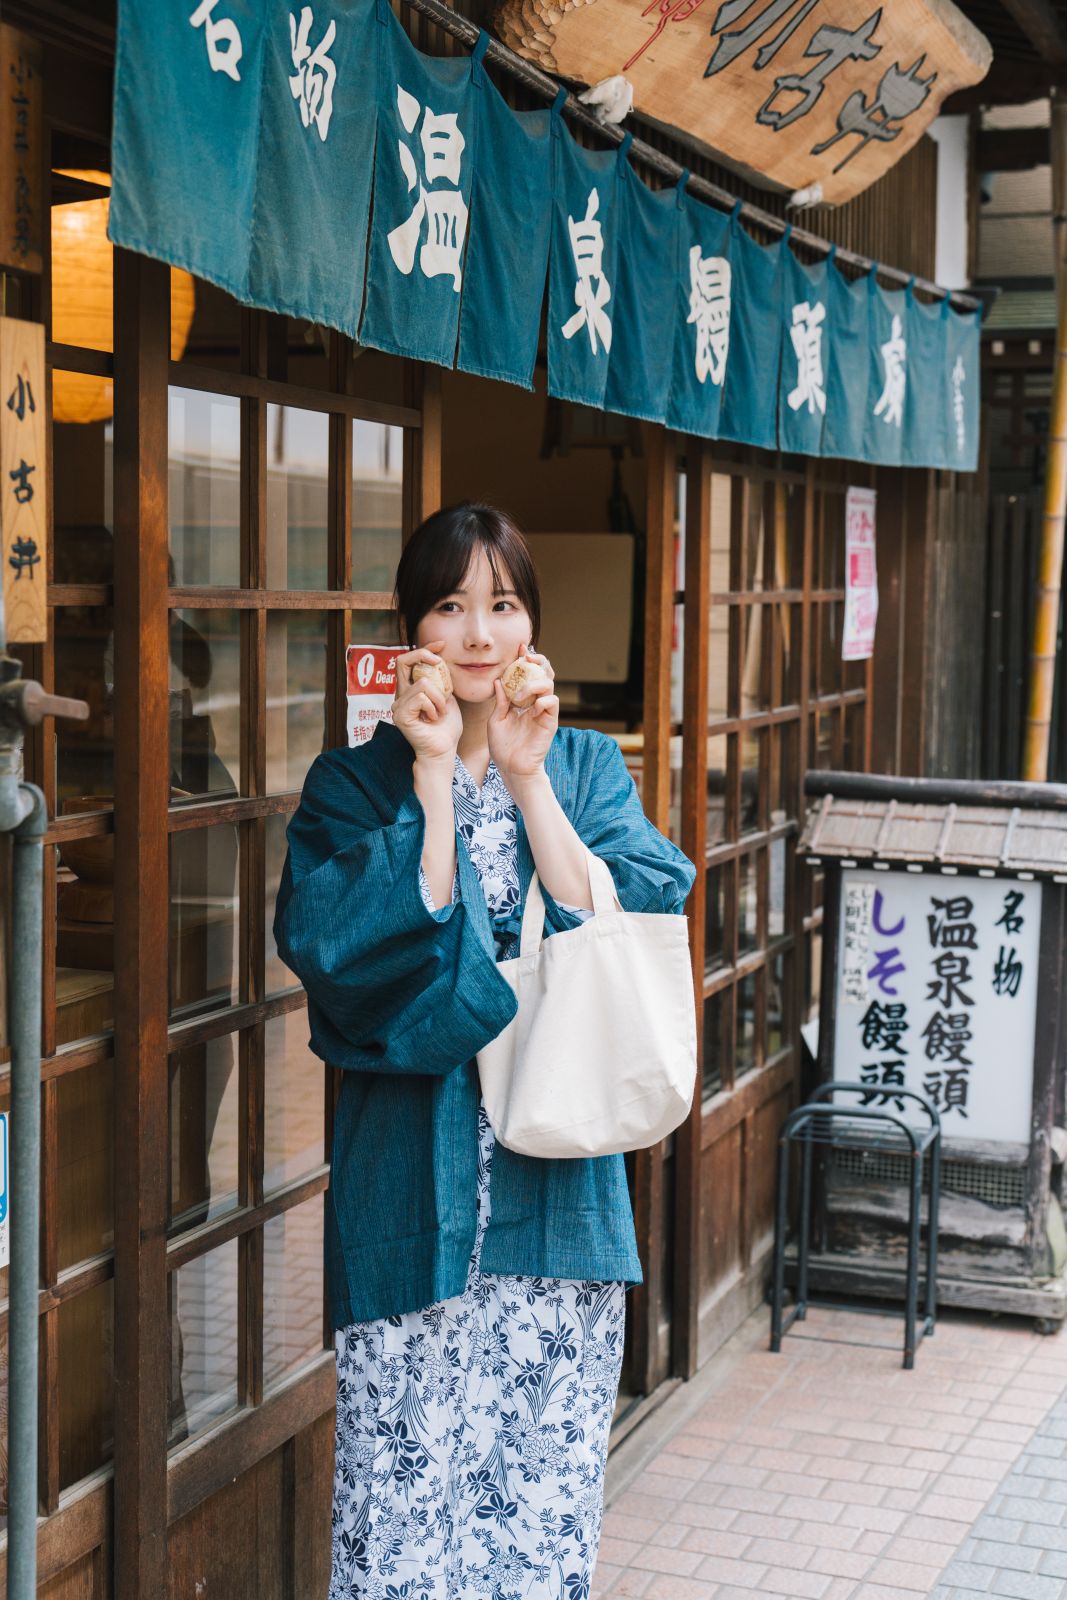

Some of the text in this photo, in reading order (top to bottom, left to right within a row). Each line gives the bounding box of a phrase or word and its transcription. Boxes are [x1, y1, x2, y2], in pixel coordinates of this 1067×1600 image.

[7, 373, 41, 581] 小古井
[376, 671, 395, 684] Dear
[857, 889, 910, 1112] しそ饅頭
[920, 896, 979, 1120] 温泉饅頭
[992, 889, 1025, 998] 名物
